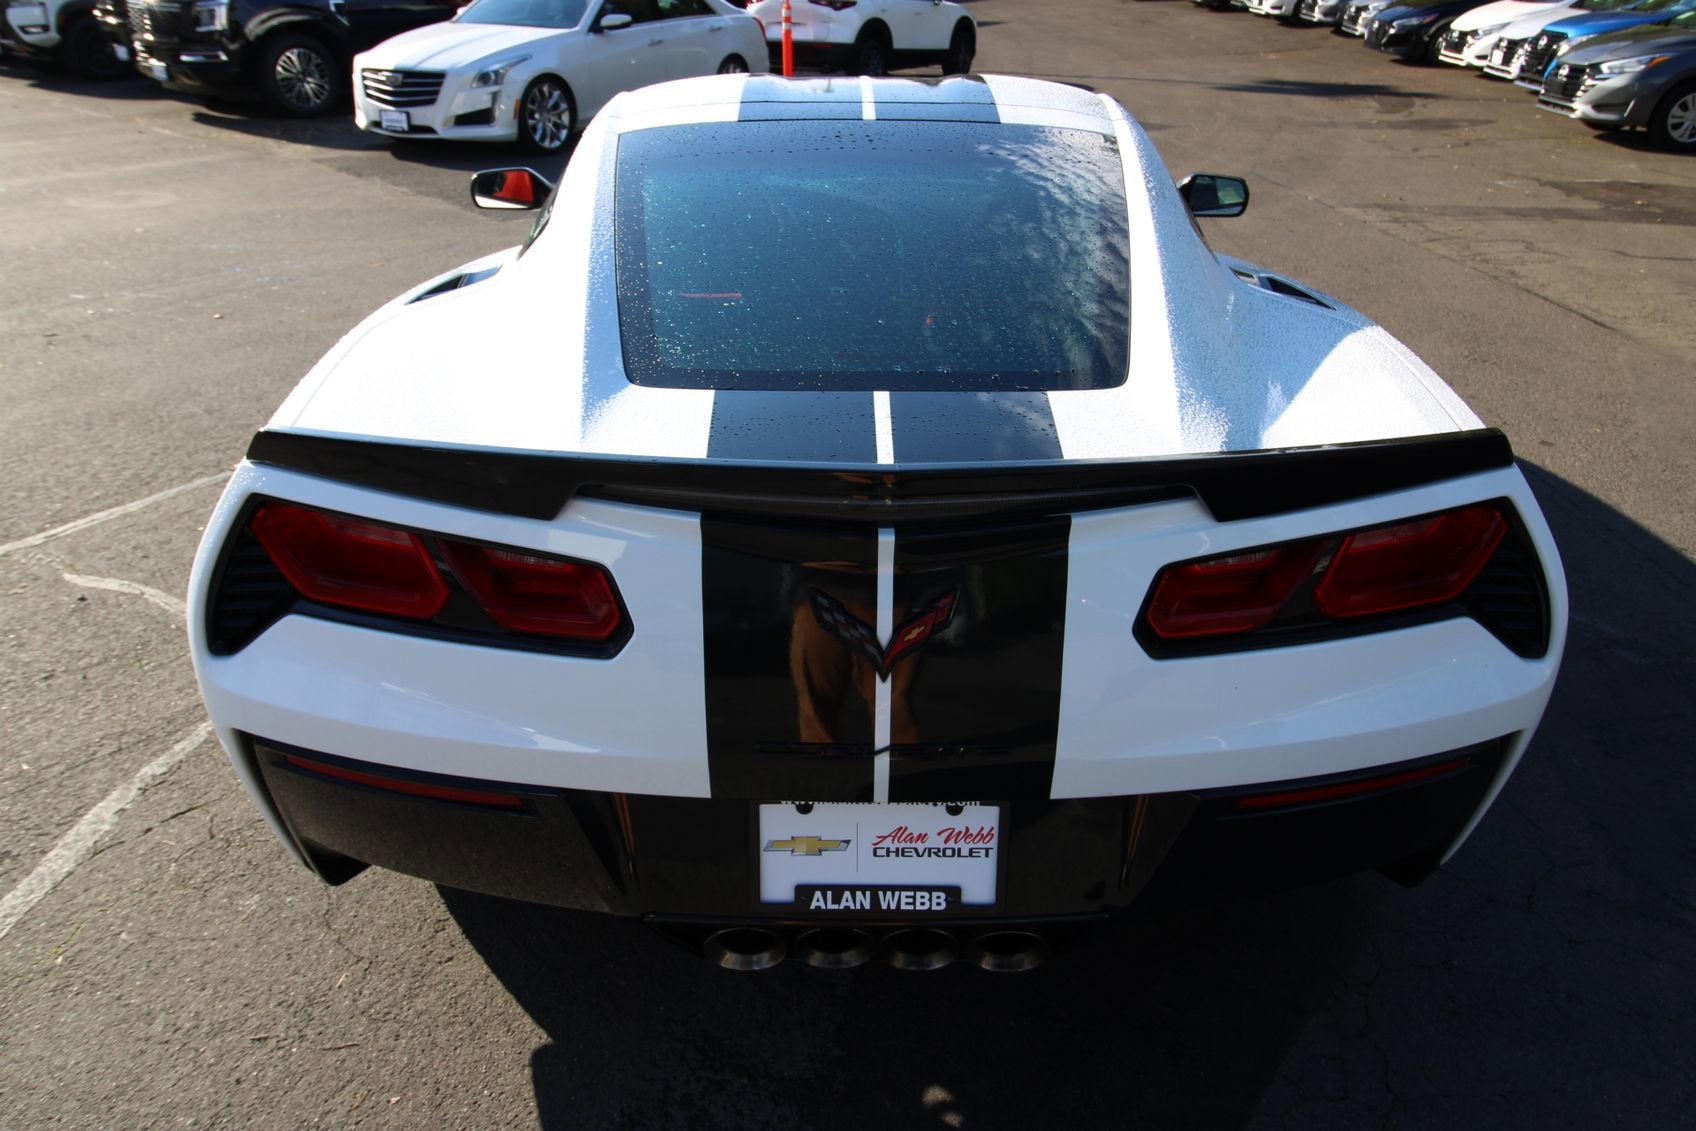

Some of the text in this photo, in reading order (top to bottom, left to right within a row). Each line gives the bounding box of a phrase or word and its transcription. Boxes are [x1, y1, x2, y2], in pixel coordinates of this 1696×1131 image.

[872, 826, 995, 846] Alan Webb
[873, 847, 993, 858] CHEVROLET
[810, 891, 946, 910] ALAN WEBB
